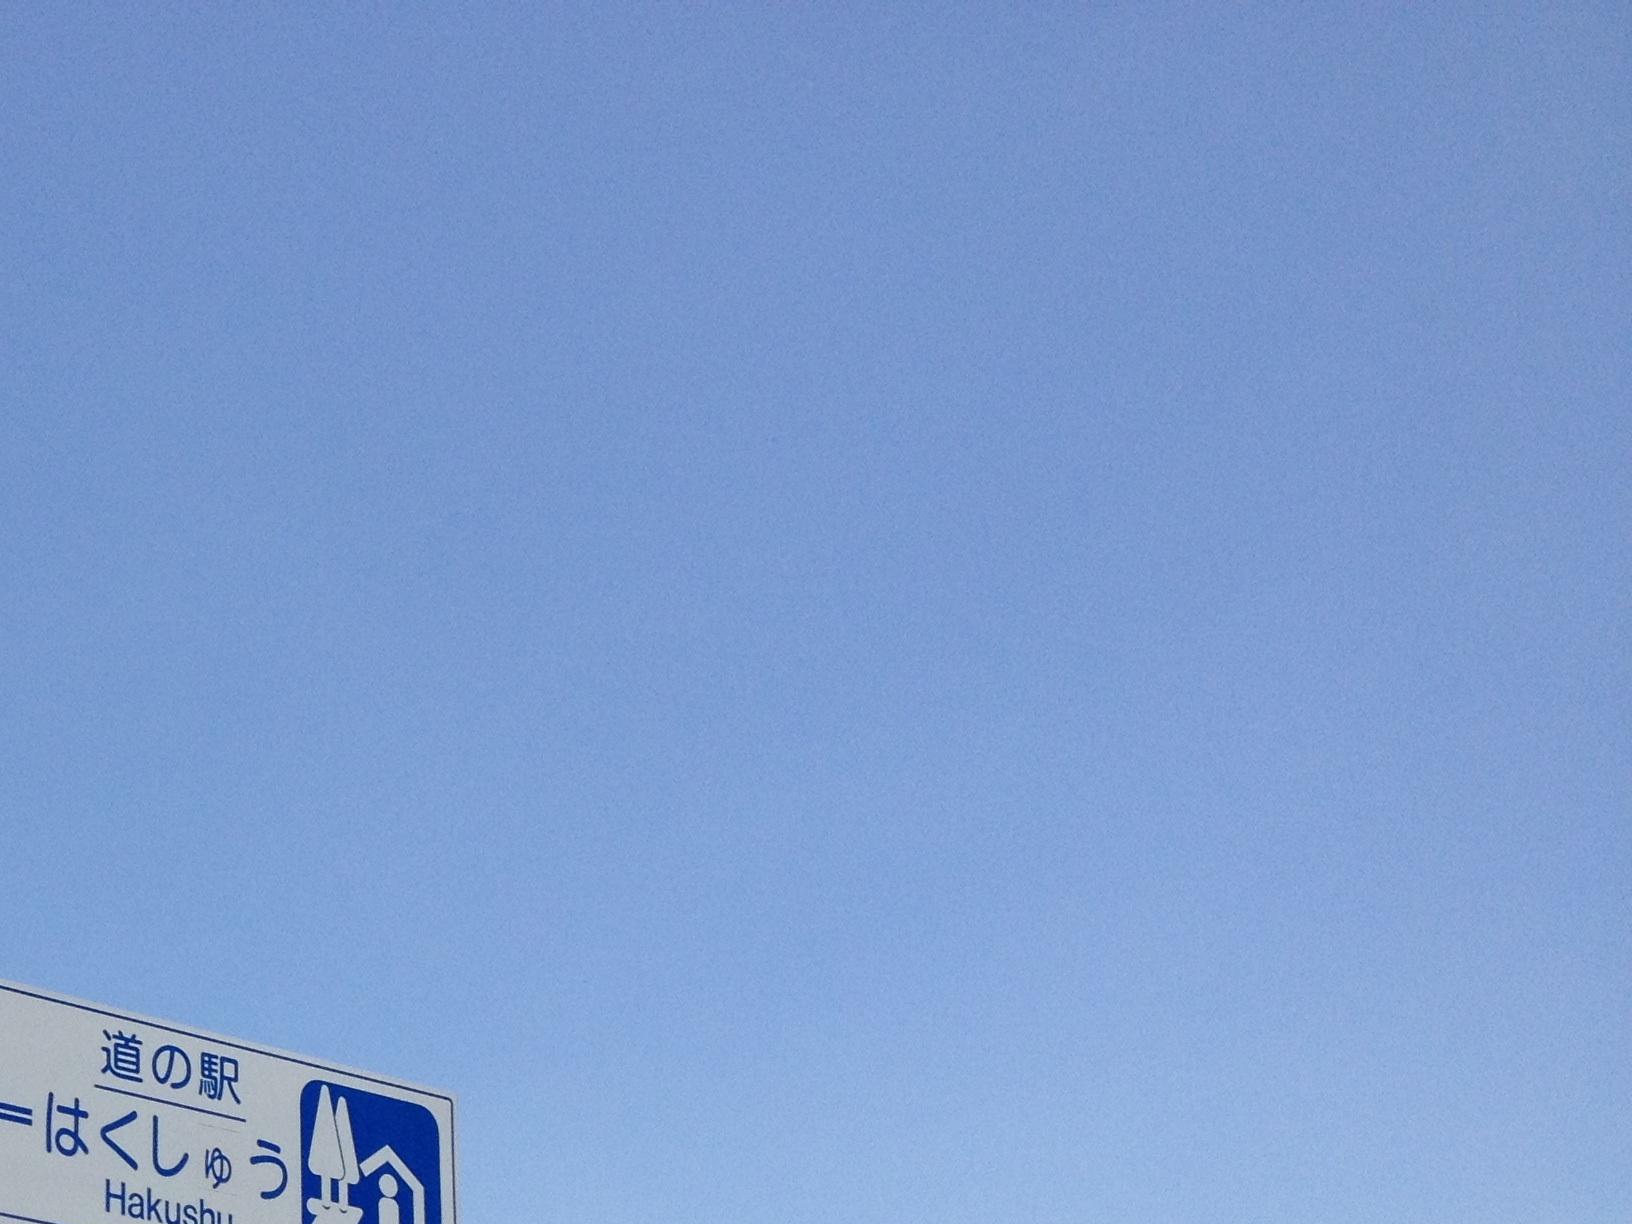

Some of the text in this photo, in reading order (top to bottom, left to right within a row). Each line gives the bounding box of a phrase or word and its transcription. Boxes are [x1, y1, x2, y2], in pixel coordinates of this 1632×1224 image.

[100, 1029, 242, 1104] 道の駅
[44, 1091, 289, 1199] はくしゅう
